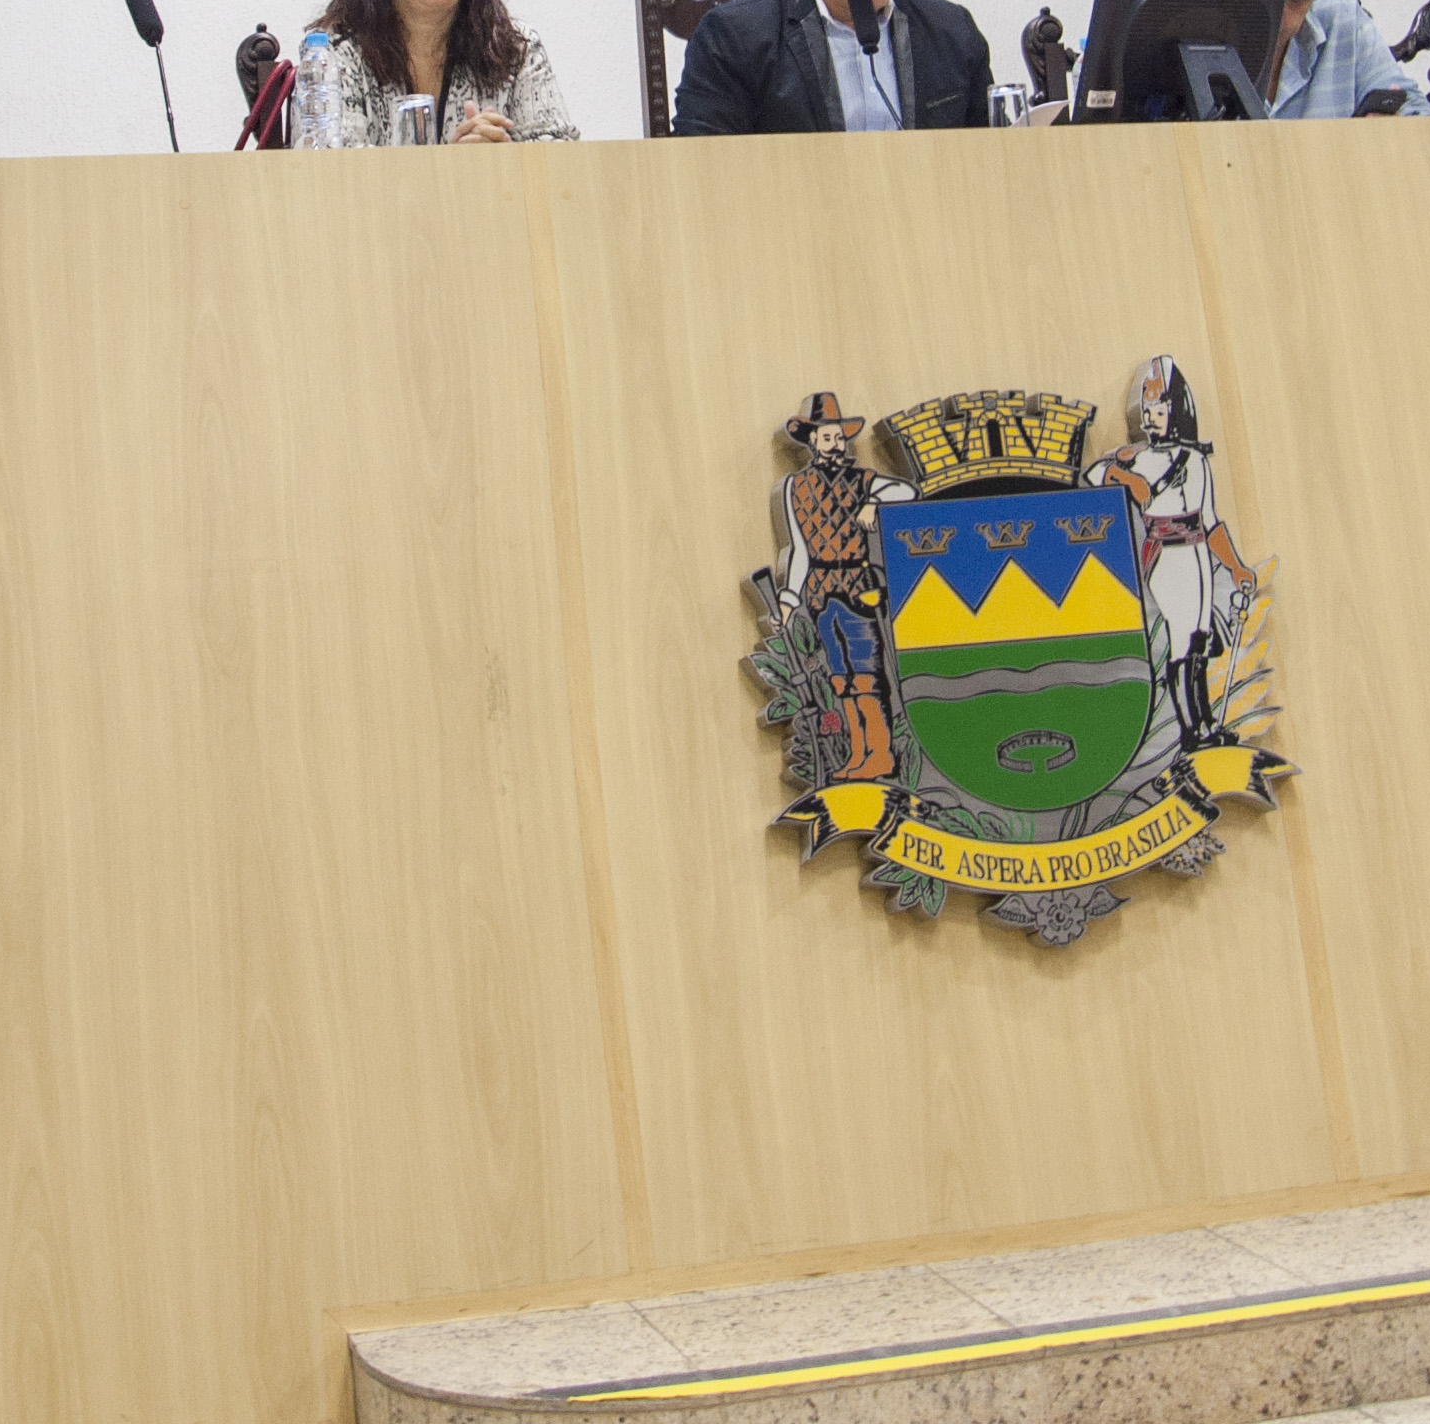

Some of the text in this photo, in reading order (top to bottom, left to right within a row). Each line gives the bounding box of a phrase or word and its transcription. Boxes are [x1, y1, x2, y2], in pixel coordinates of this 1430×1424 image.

[956, 850, 1044, 884] ASPERA
[1048, 851, 1092, 883] PRO
[1094, 805, 1192, 873] BRASILIA
